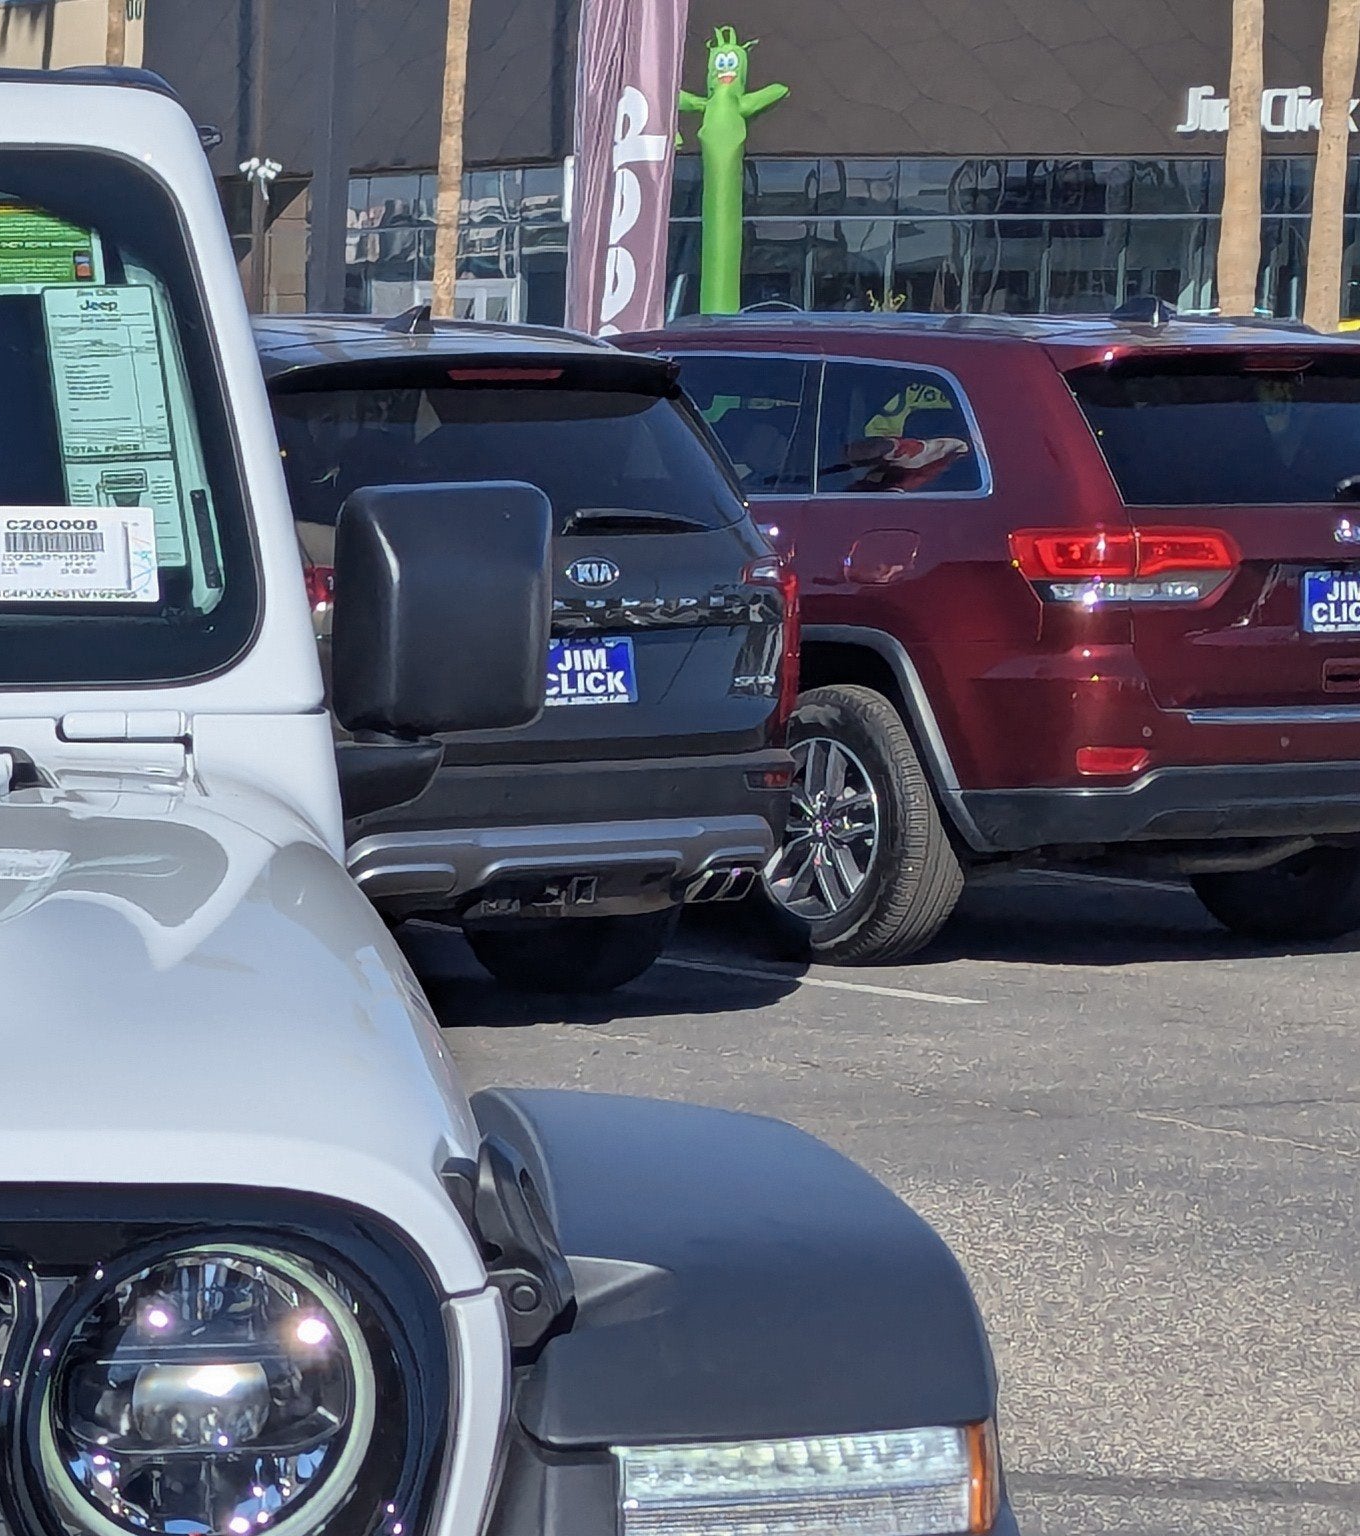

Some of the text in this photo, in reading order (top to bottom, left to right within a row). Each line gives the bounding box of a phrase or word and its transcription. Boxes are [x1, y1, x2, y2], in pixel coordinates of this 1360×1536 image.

[598, 86, 668, 337] eep
[79, 299, 119, 312] Jeep
[65, 443, 141, 453] TOTAL PRICE
[6, 519, 98, 531] C260008
[576, 563, 613, 583] KIA
[1311, 602, 1360, 623] CLIC
[556, 648, 610, 672] JIM
[545, 670, 627, 696] CLICK
